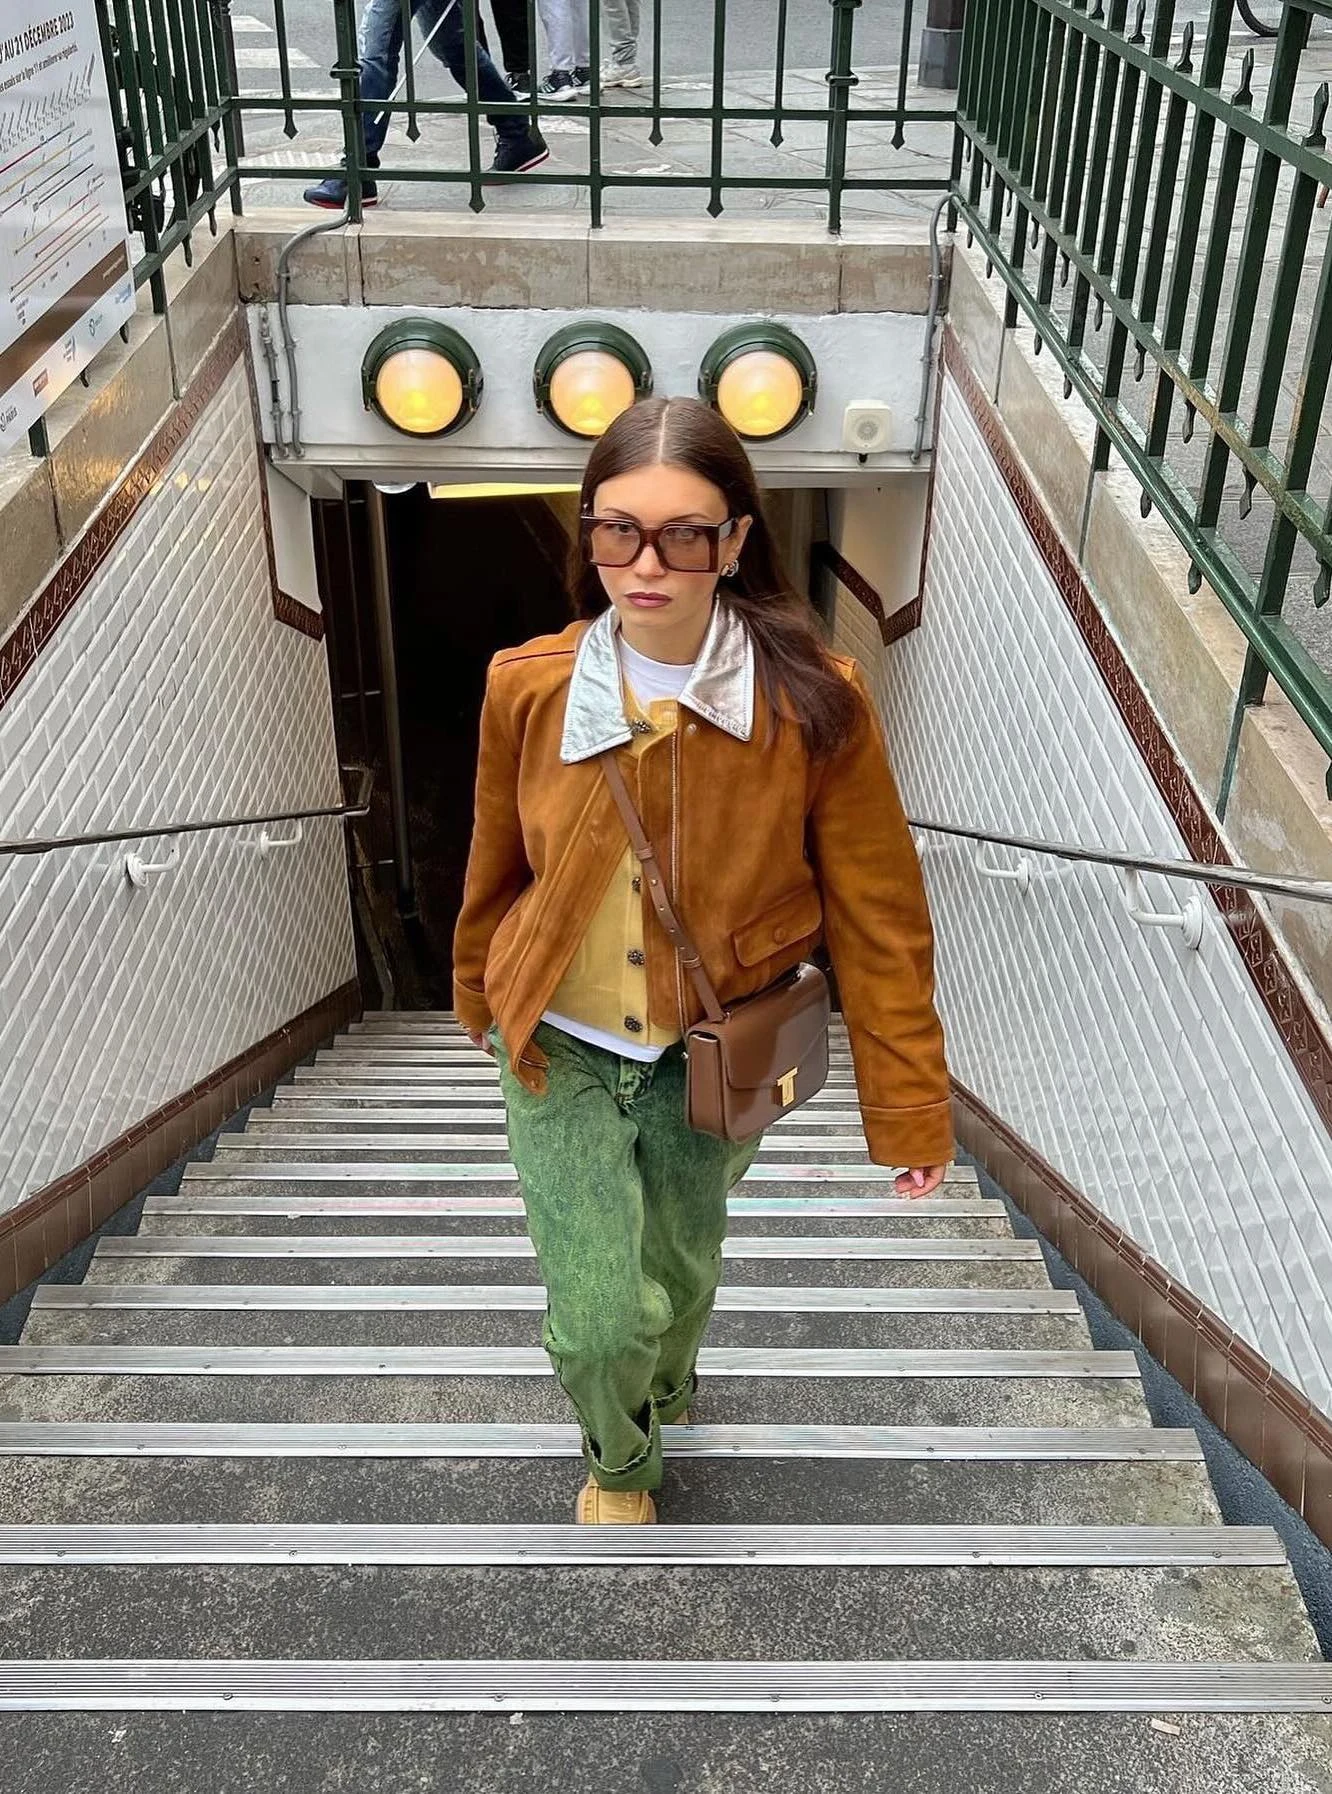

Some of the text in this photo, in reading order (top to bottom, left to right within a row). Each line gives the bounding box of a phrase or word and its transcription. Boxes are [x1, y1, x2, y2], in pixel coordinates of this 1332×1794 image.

[14, 34, 24, 55] 21
[24, 18, 58, 50] DÉCEMBRE
[58, 11, 74, 33] 2023
